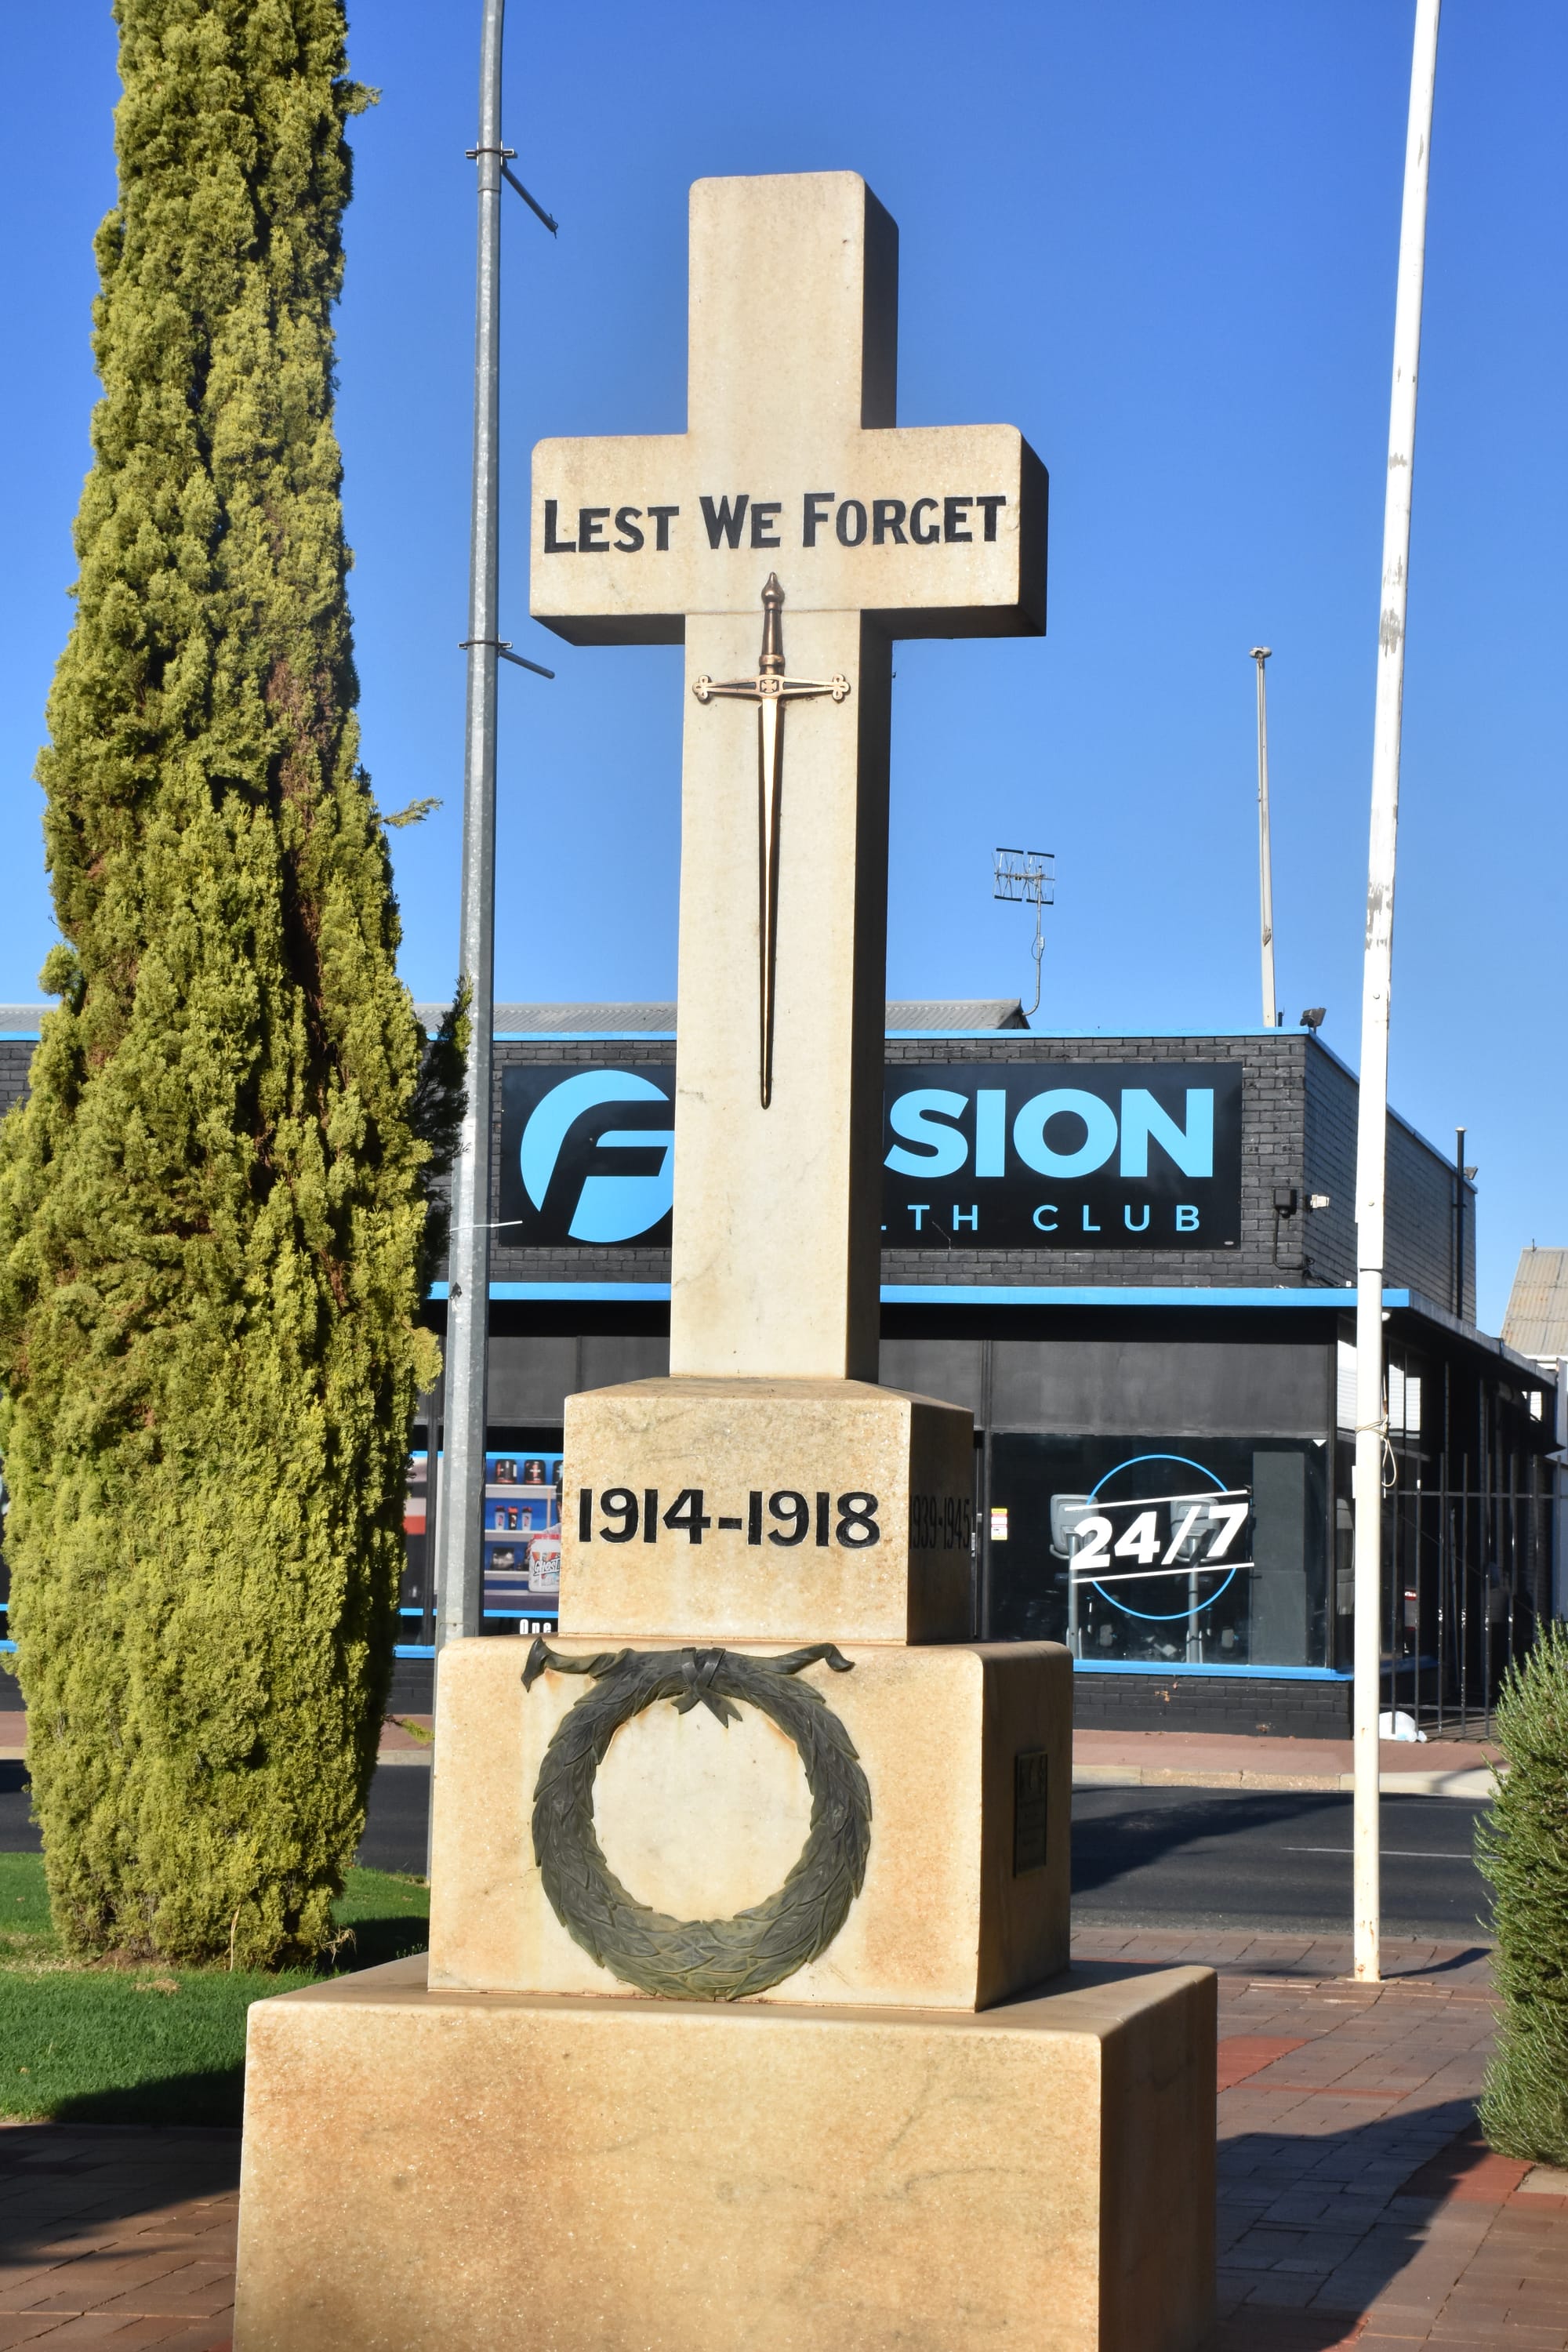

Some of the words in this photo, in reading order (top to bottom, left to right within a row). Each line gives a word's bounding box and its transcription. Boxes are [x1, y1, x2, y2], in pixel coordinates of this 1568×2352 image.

[884, 1088, 1214, 1178] SION
[880, 1205, 978, 1231] TH
[1033, 1205, 1200, 1232] CLUB
[579, 1487, 880, 1549] 1914-1918
[1070, 1503, 1248, 1569] 24/7
